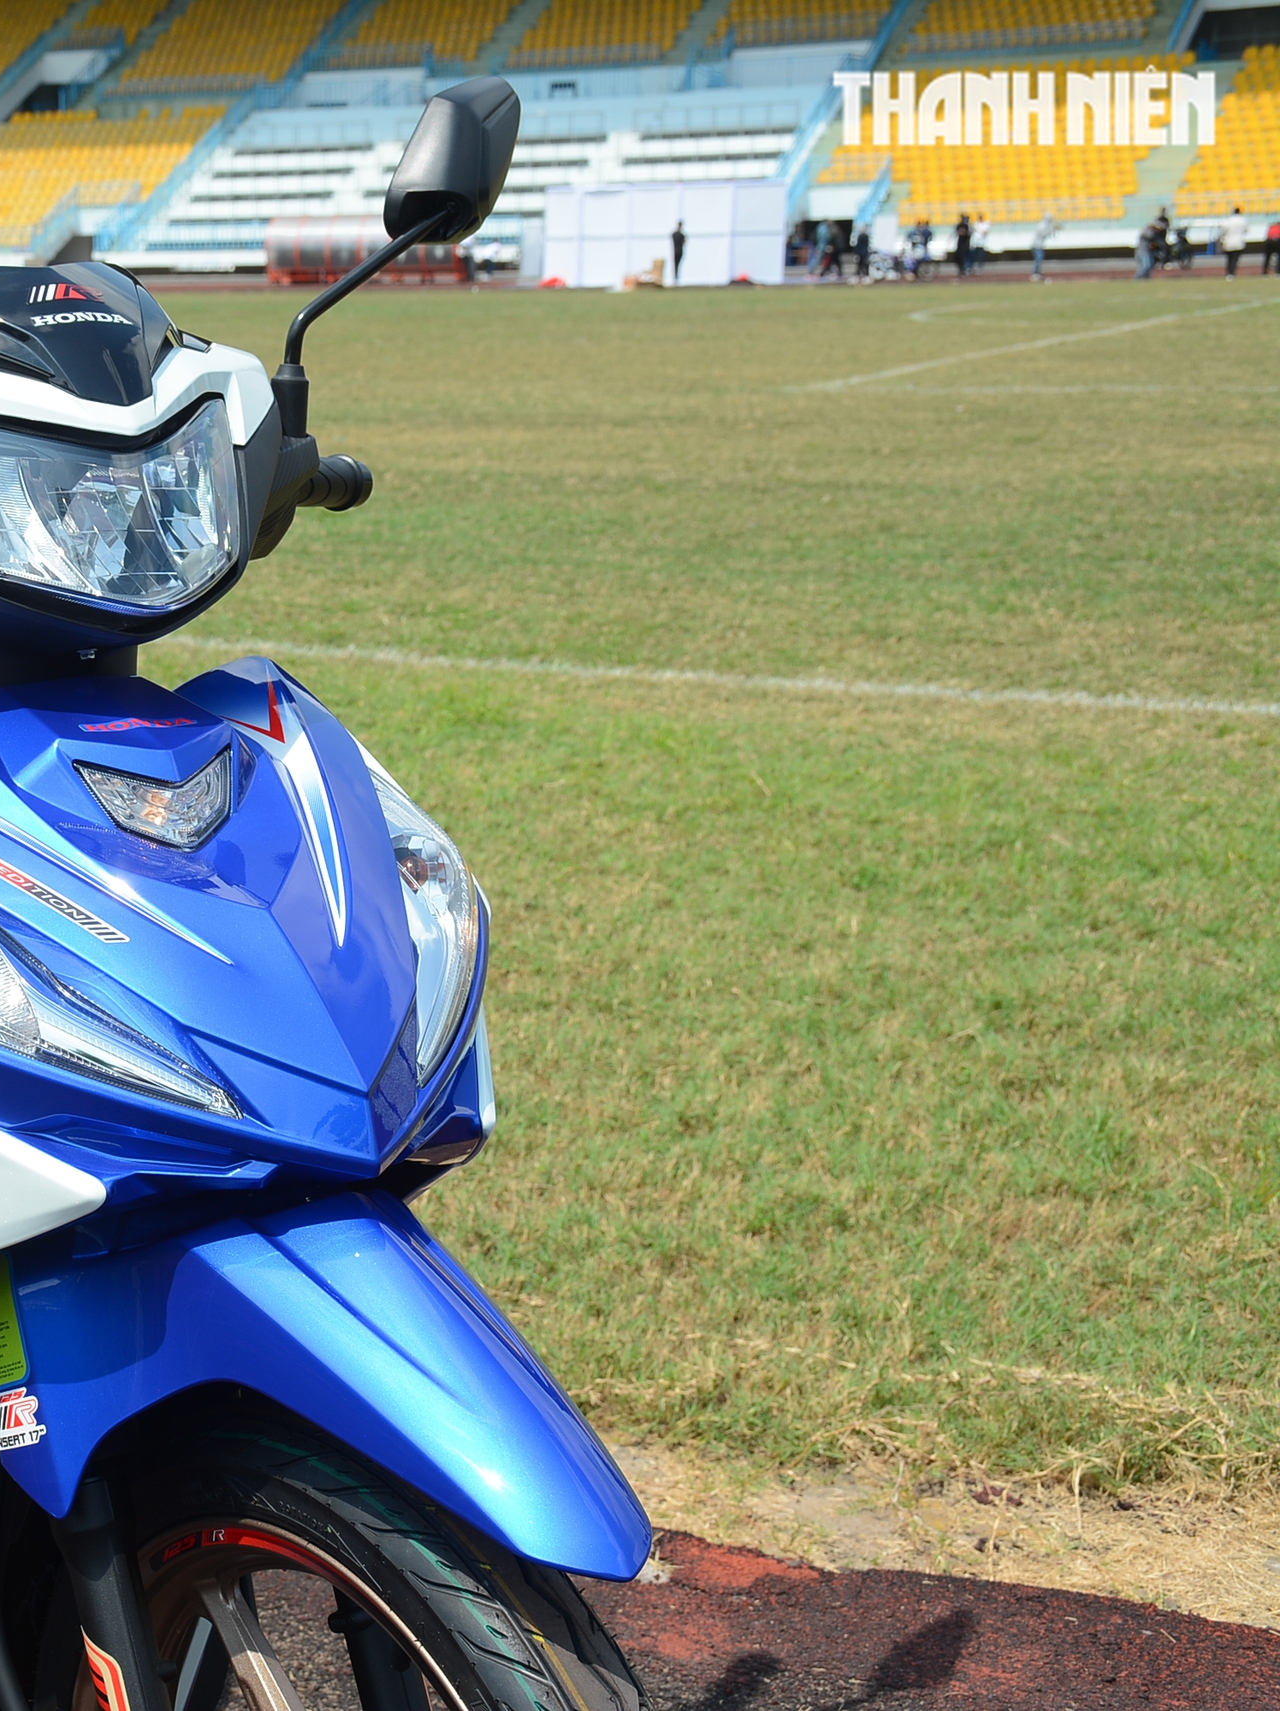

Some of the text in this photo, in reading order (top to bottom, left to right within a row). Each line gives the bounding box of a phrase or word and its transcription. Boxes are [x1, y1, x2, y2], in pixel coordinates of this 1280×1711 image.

[29, 311, 134, 327] HONDA
[82, 718, 195, 732] HONDA
[212, 1529, 225, 1542] R
